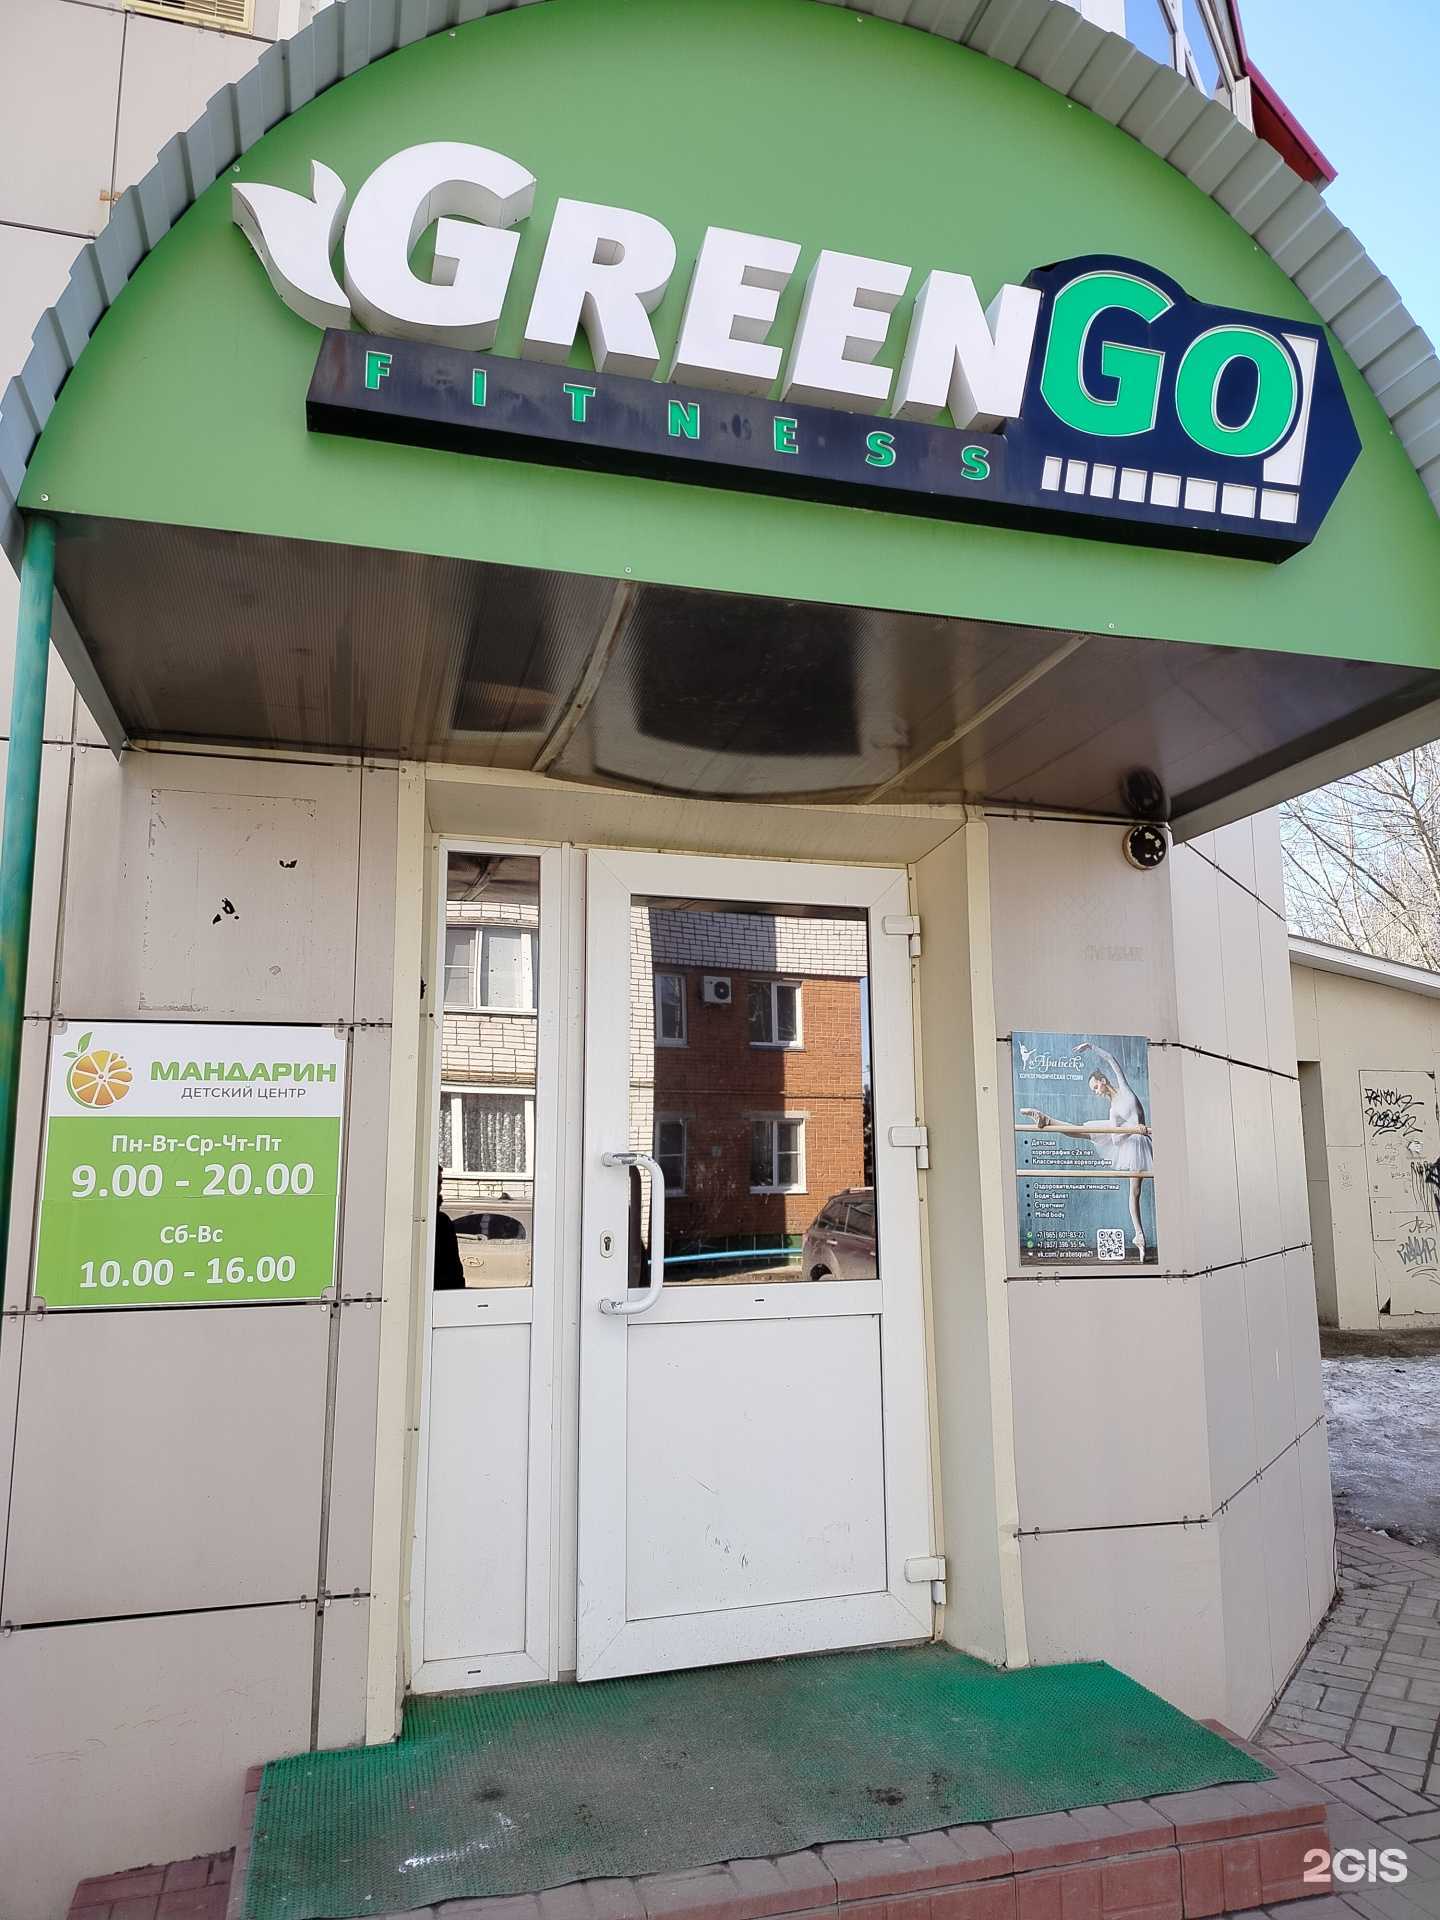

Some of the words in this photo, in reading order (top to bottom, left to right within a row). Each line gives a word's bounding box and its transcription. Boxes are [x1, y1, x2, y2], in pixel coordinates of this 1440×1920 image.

[362, 349, 994, 482] FITNESS
[150, 1061, 337, 1083] МАНДАРИН
[181, 1085, 253, 1100] ДЕТСКИЙ
[257, 1087, 306, 1099] ЦЕНТР
[111, 1134, 282, 1155] Пн-Вт-Ср-Чт-Пт
[71, 1164, 164, 1198] 9.00
[202, 1163, 314, 1196] 20.00
[1050, 1211, 1065, 1219] body
[159, 1224, 224, 1244] Сб-Вс
[79, 1259, 174, 1288] 10.00
[206, 1256, 296, 1284] 16.00
